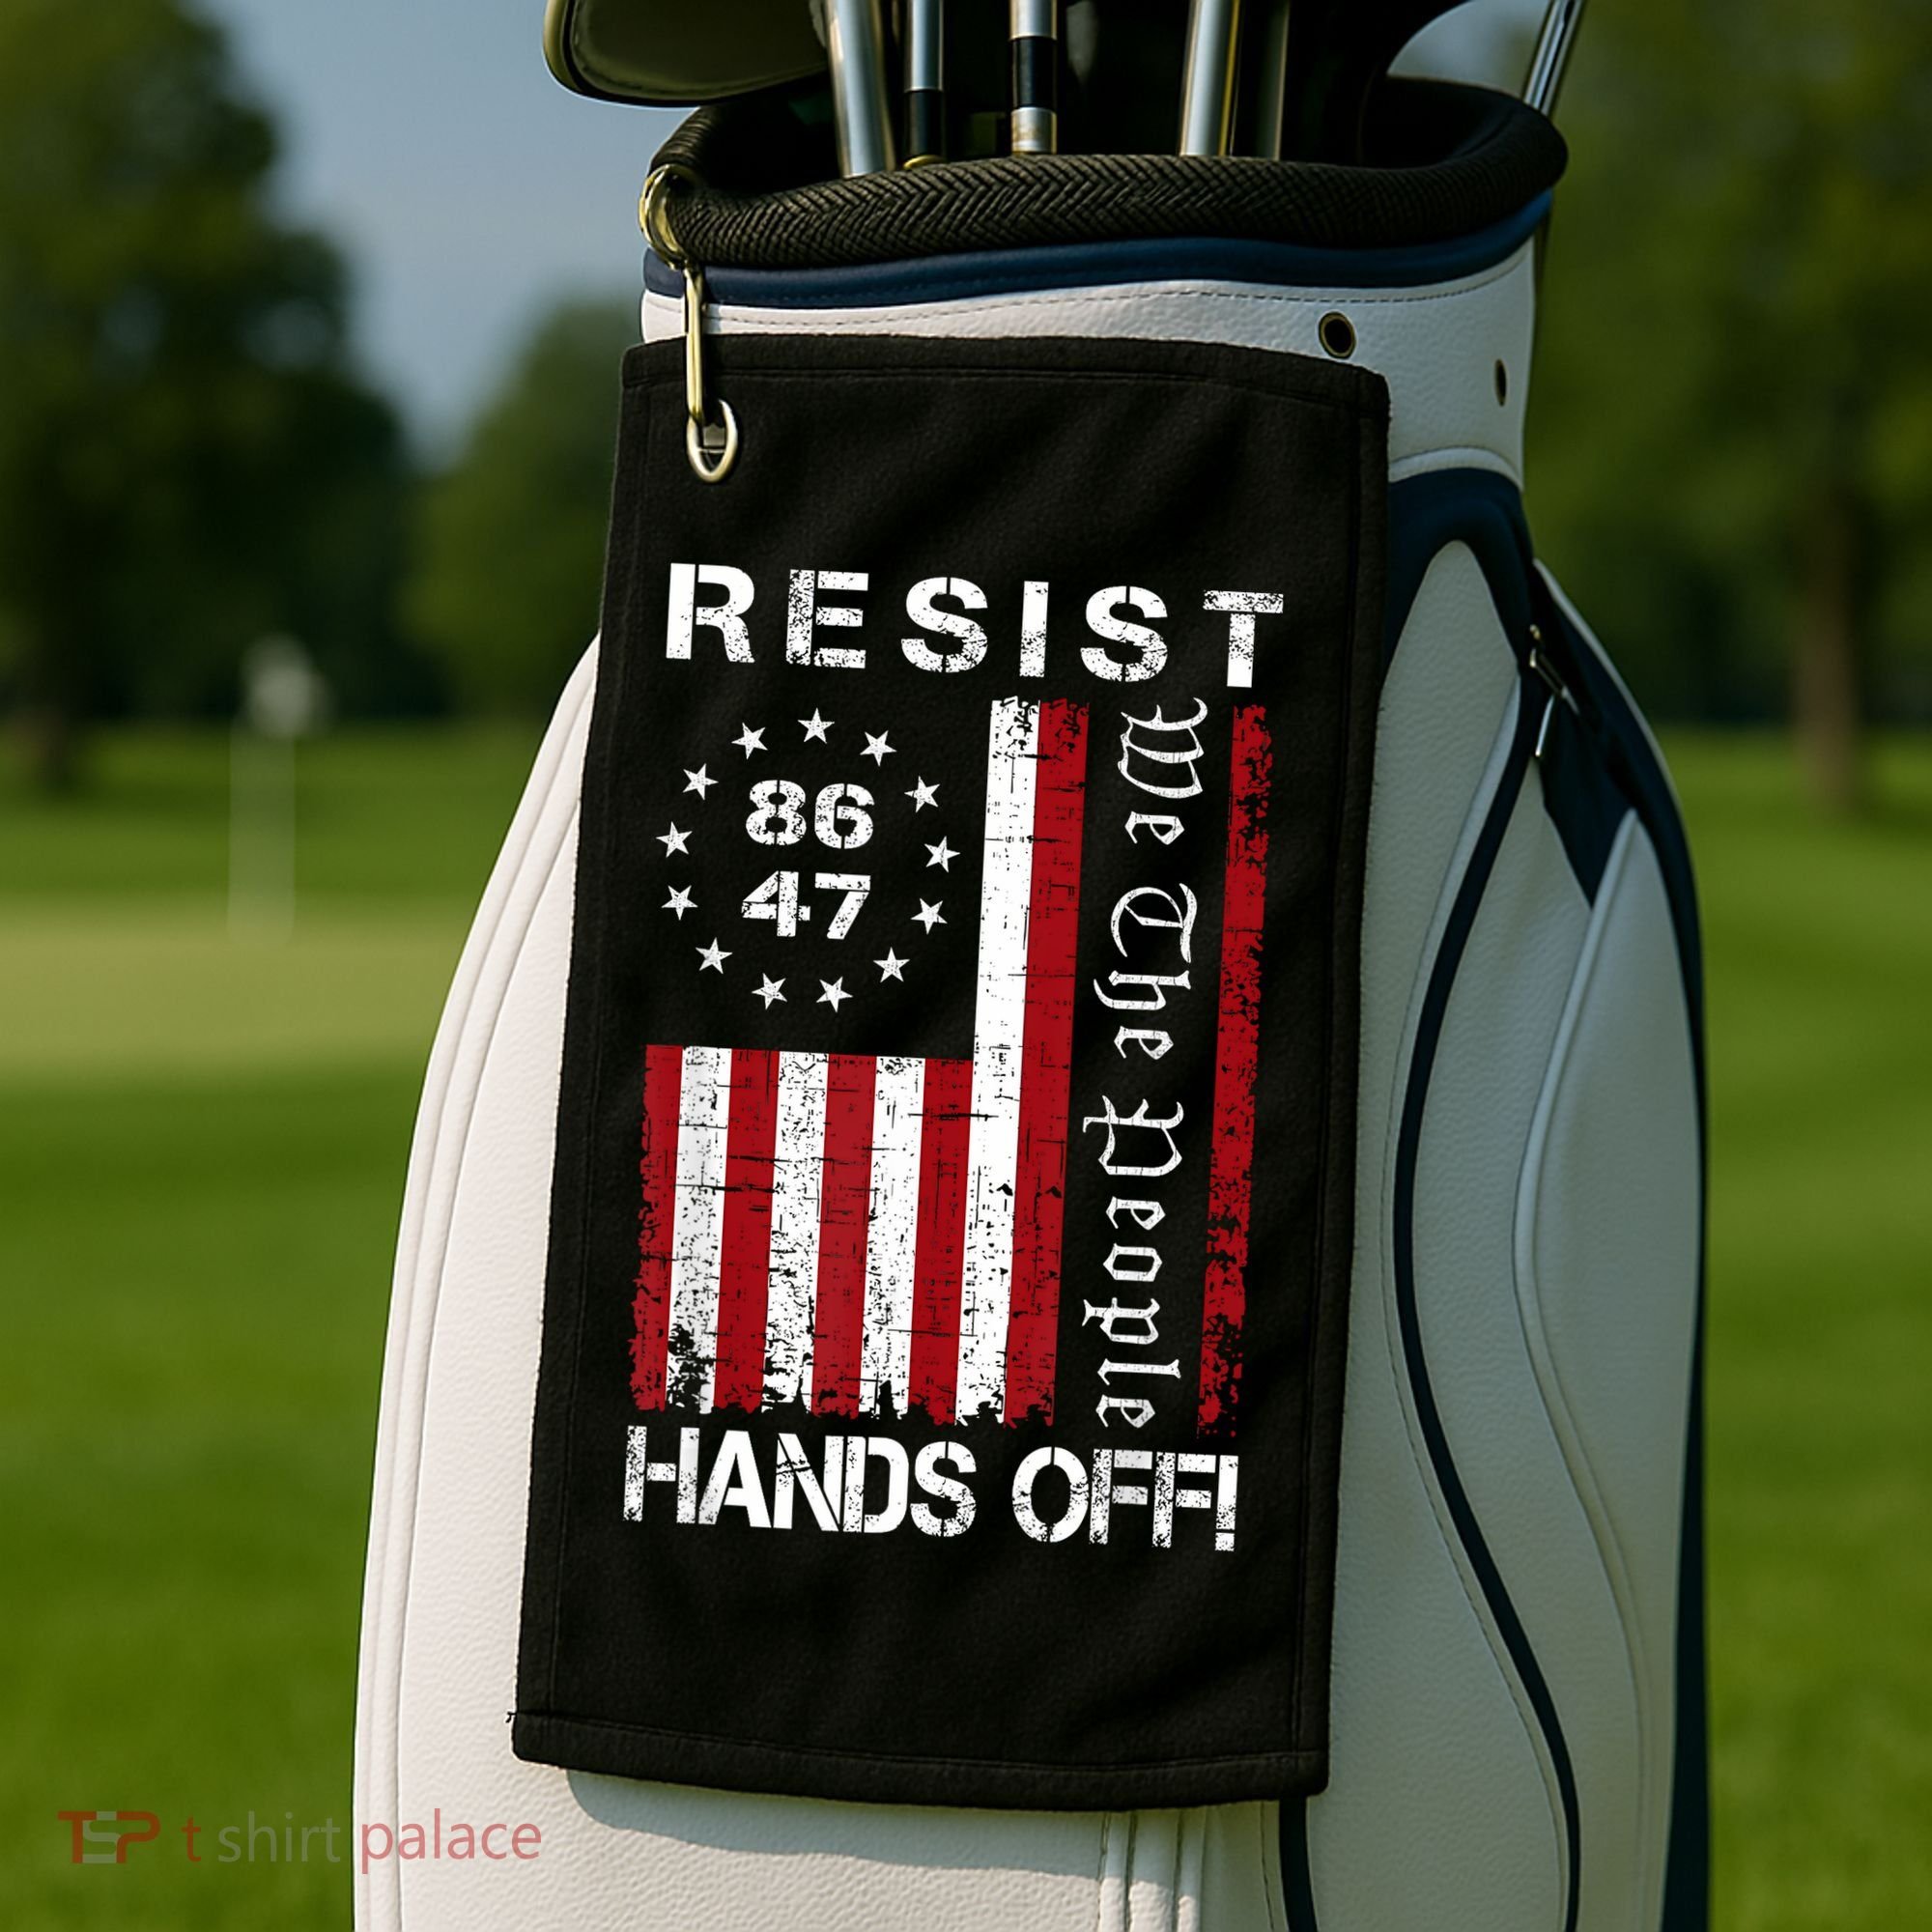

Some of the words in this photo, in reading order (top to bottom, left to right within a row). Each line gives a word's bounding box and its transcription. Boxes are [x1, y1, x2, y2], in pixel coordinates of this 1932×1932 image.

[667, 563, 1283, 688] RESIST
[746, 780, 874, 849] 86
[1118, 697, 1208, 844] We
[742, 871, 870, 939] 47
[1094, 883, 1197, 1060] The
[1082, 1095, 1183, 1428] People
[624, 1426, 976, 1537] HANDS
[1012, 1447, 1238, 1551] OFF!
